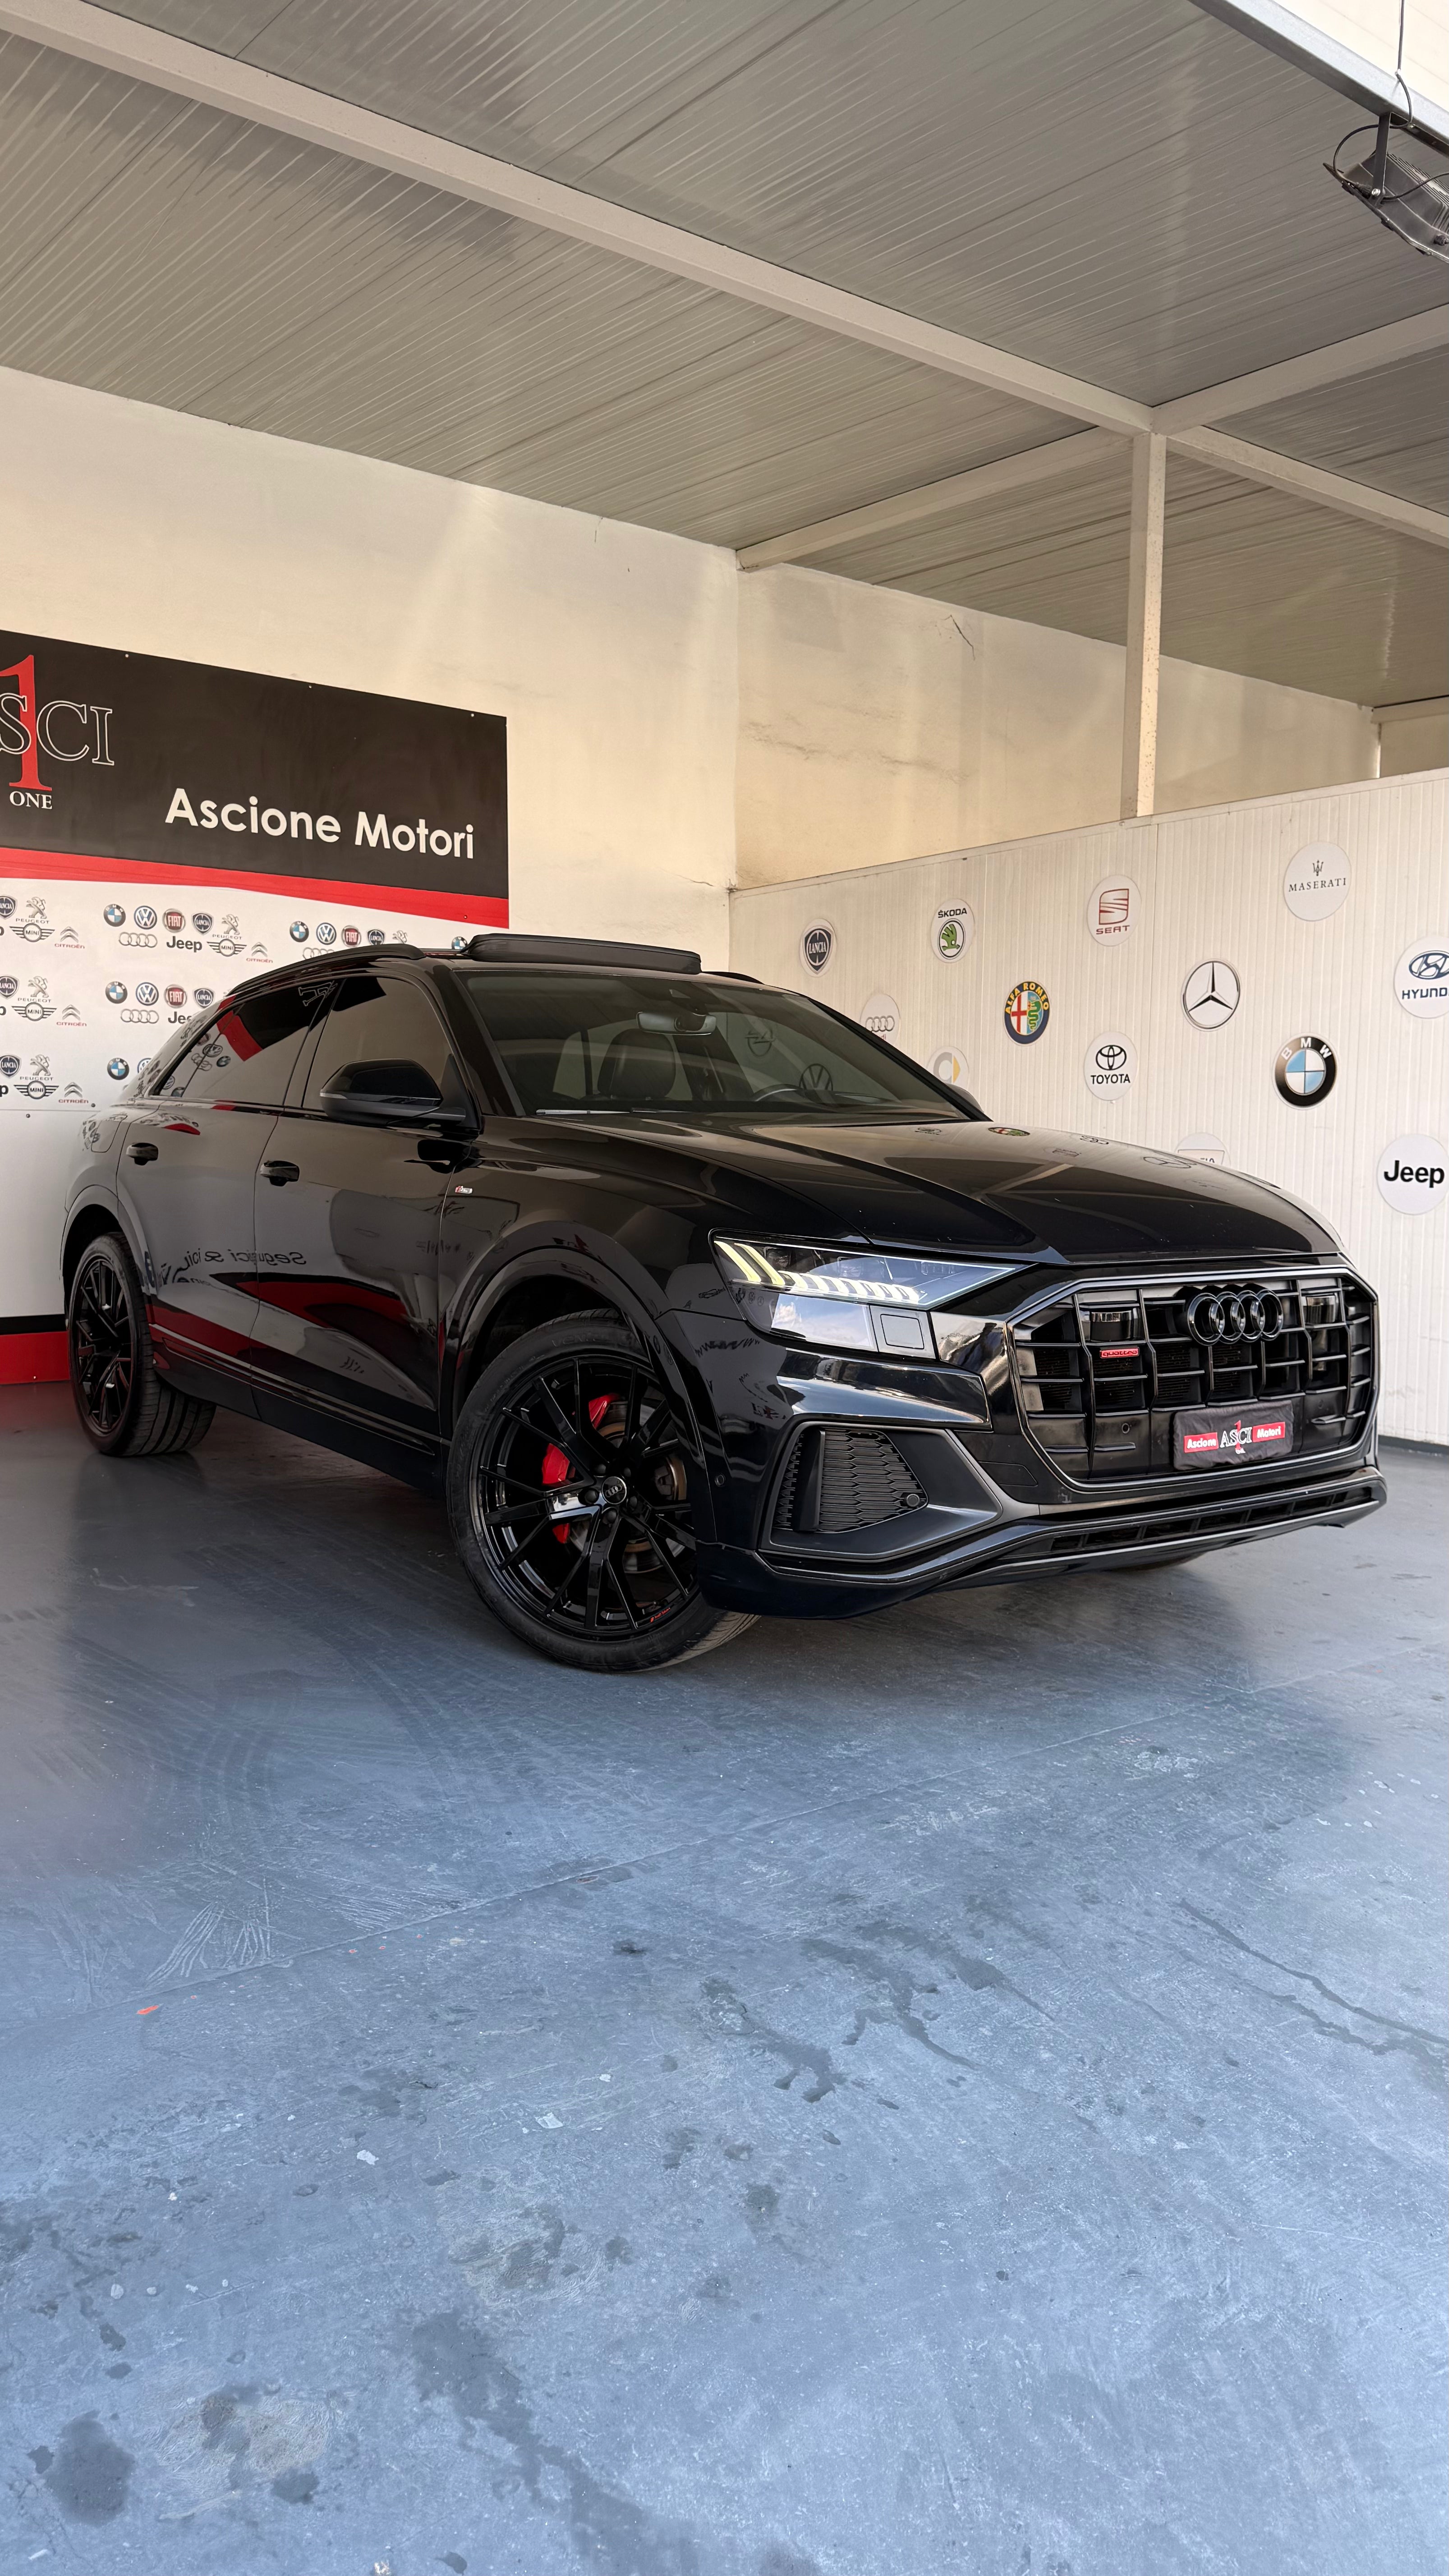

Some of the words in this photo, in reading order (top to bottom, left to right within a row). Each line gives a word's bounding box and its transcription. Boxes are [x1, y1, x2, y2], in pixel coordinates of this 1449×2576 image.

[9, 791, 52, 810] ONE
[165, 788, 341, 842] Ascione
[355, 811, 474, 859] Motori
[1288, 878, 1346, 892] MASERATI
[938, 908, 967, 918] ŠKODA
[168, 915, 181, 927] FIAT
[1096, 925, 1130, 934] SEAT
[166, 936, 202, 952] Jeep
[346, 932, 358, 943] FIAT
[809, 942, 827, 954] LANCIA
[169, 991, 183, 1003] FIAT
[1005, 988, 1021, 1014] ALFA
[1023, 983, 1049, 1011] ROMEO
[1402, 987, 1449, 1000] HYUND
[1281, 1037, 1332, 1060] BMW
[1090, 1074, 1131, 1085] TOYOTA
[1384, 1160, 1445, 1188] Jeep
[1187, 1438, 1217, 1449] Ascione
[1220, 1426, 1252, 1448] ASCI
[1257, 1426, 1281, 1439] Motori
